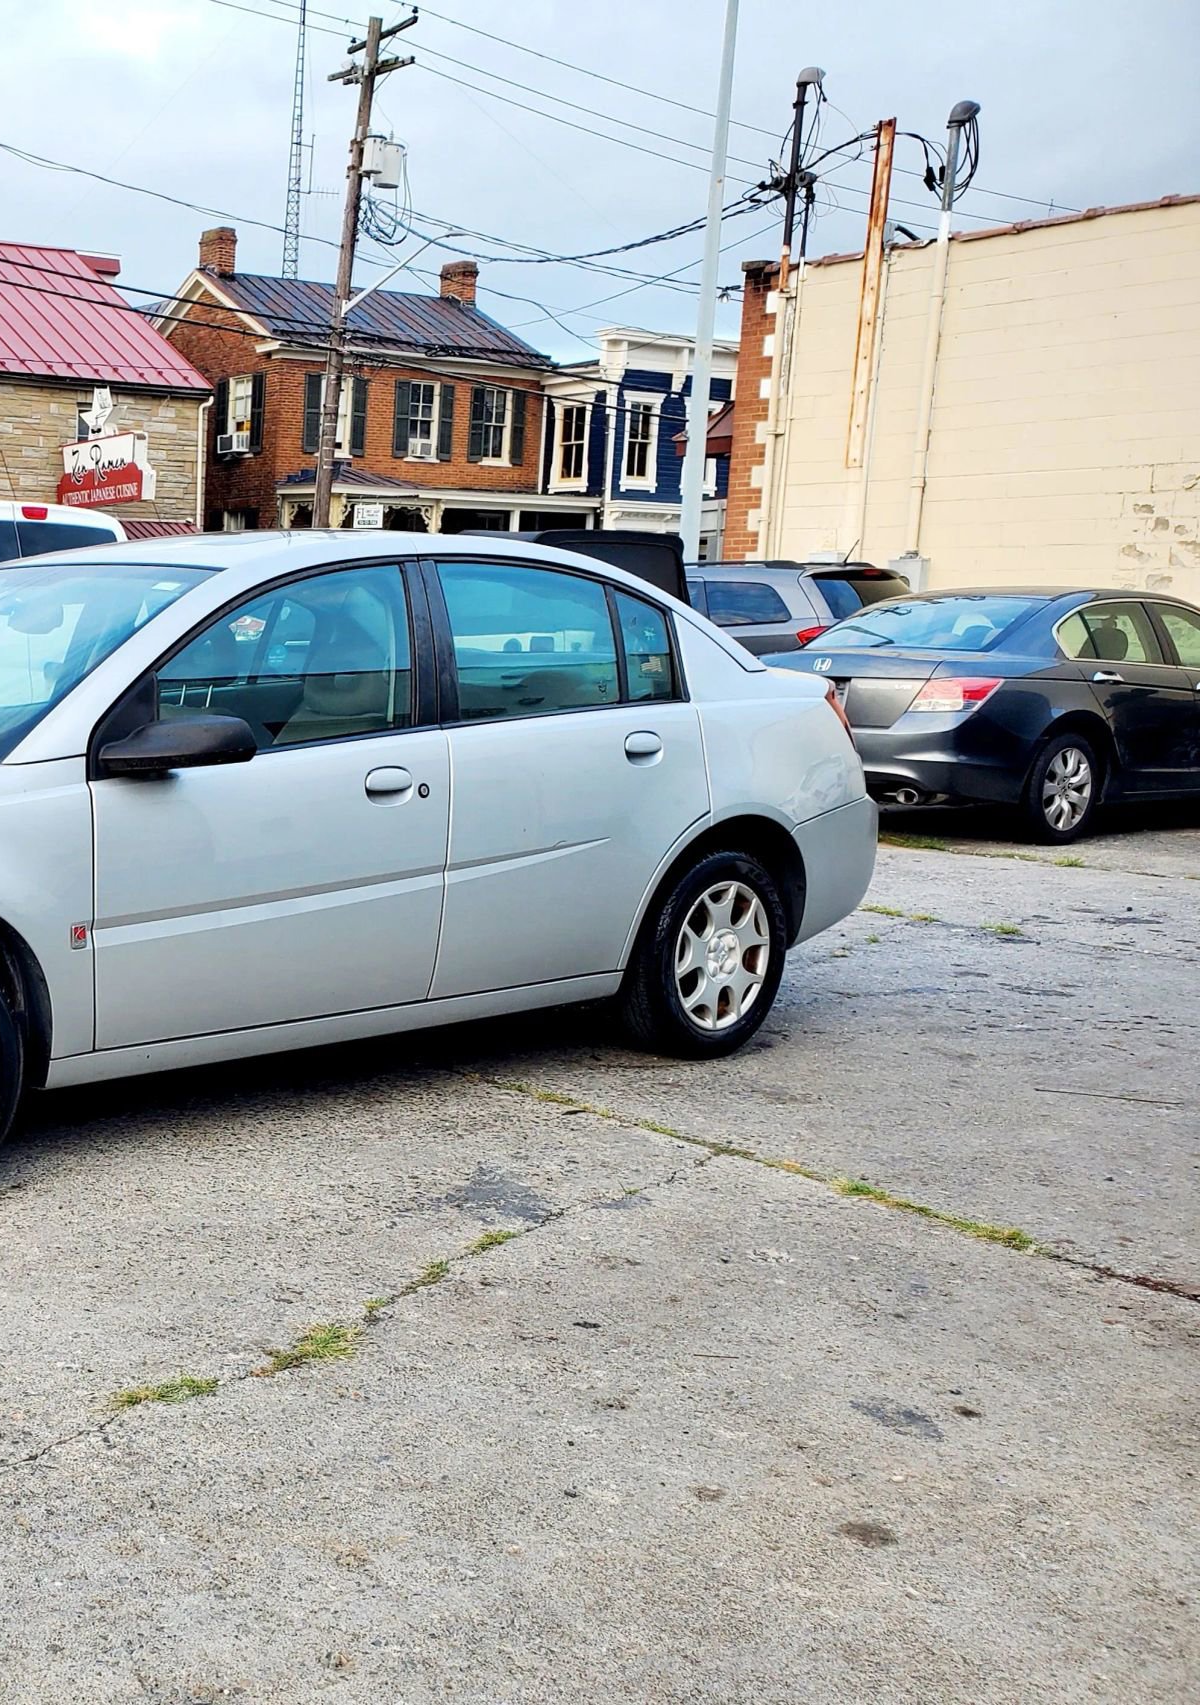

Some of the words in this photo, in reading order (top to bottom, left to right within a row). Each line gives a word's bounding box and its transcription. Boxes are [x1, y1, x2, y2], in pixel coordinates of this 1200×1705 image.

[71, 449, 87, 484] Zen
[90, 444, 127, 486] Ramen
[63, 489, 89, 506] AUTHENTIC
[91, 485, 116, 502] JAPANESE
[116, 482, 138, 498] CUISINE
